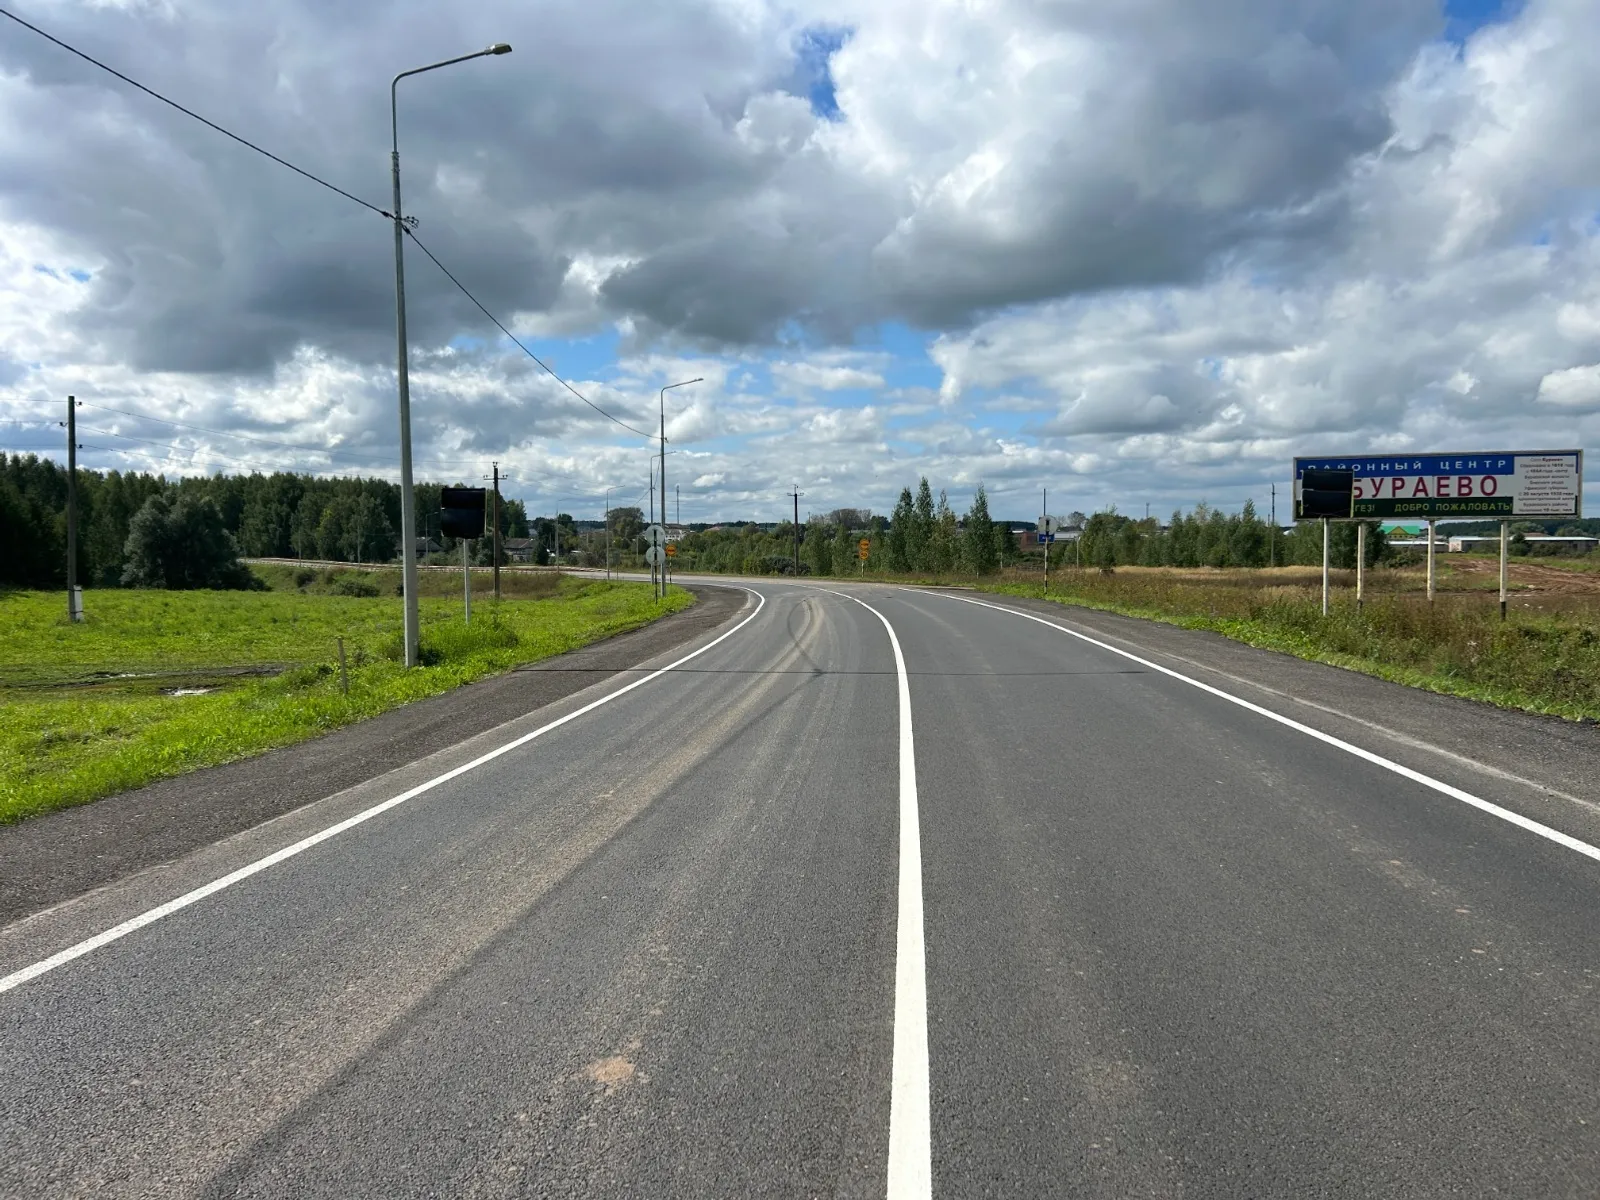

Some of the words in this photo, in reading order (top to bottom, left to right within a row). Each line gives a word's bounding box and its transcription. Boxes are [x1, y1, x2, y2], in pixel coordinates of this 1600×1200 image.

[1440, 460, 1506, 470] ЦЕНТР
[1353, 475, 1498, 499] БУРАЕВО
[1394, 503, 1430, 512] ДОБРО
